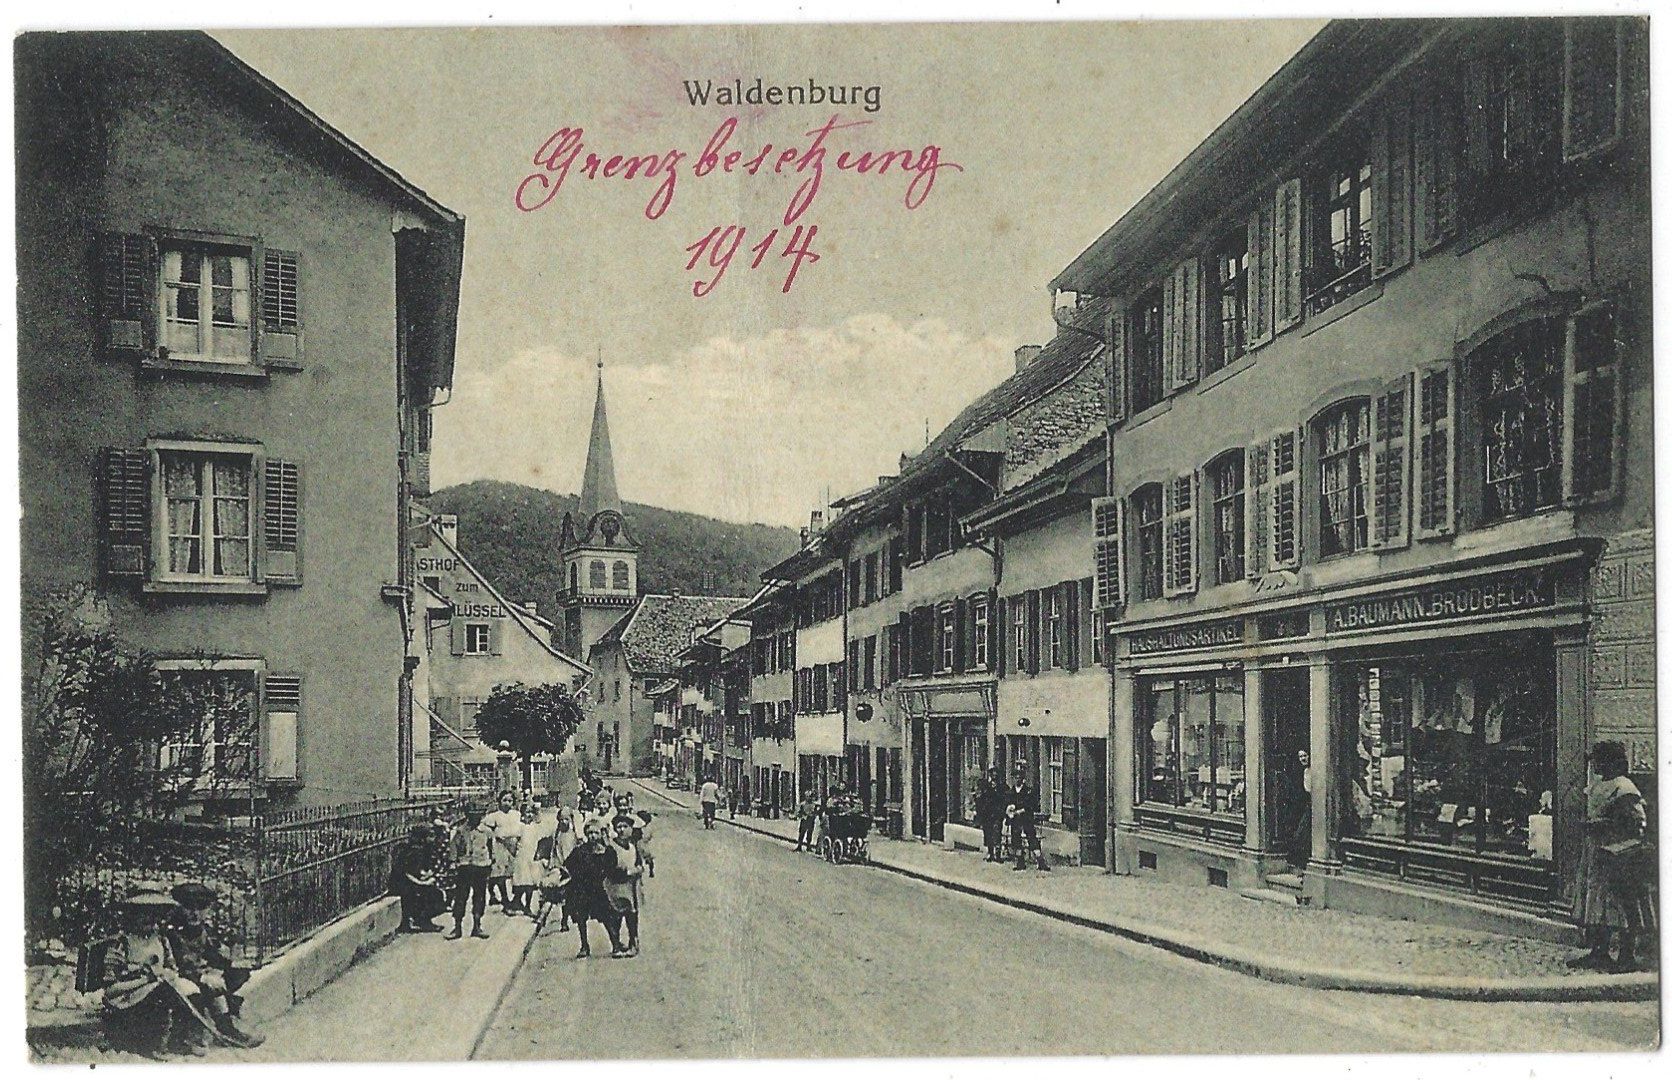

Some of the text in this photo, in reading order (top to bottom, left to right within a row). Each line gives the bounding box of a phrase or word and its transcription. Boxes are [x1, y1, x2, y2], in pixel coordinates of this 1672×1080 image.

[515, 114, 964, 226] Grenzbesetzung
[686, 224, 820, 297] 1914
[452, 600, 507, 618] LÜSSEL
